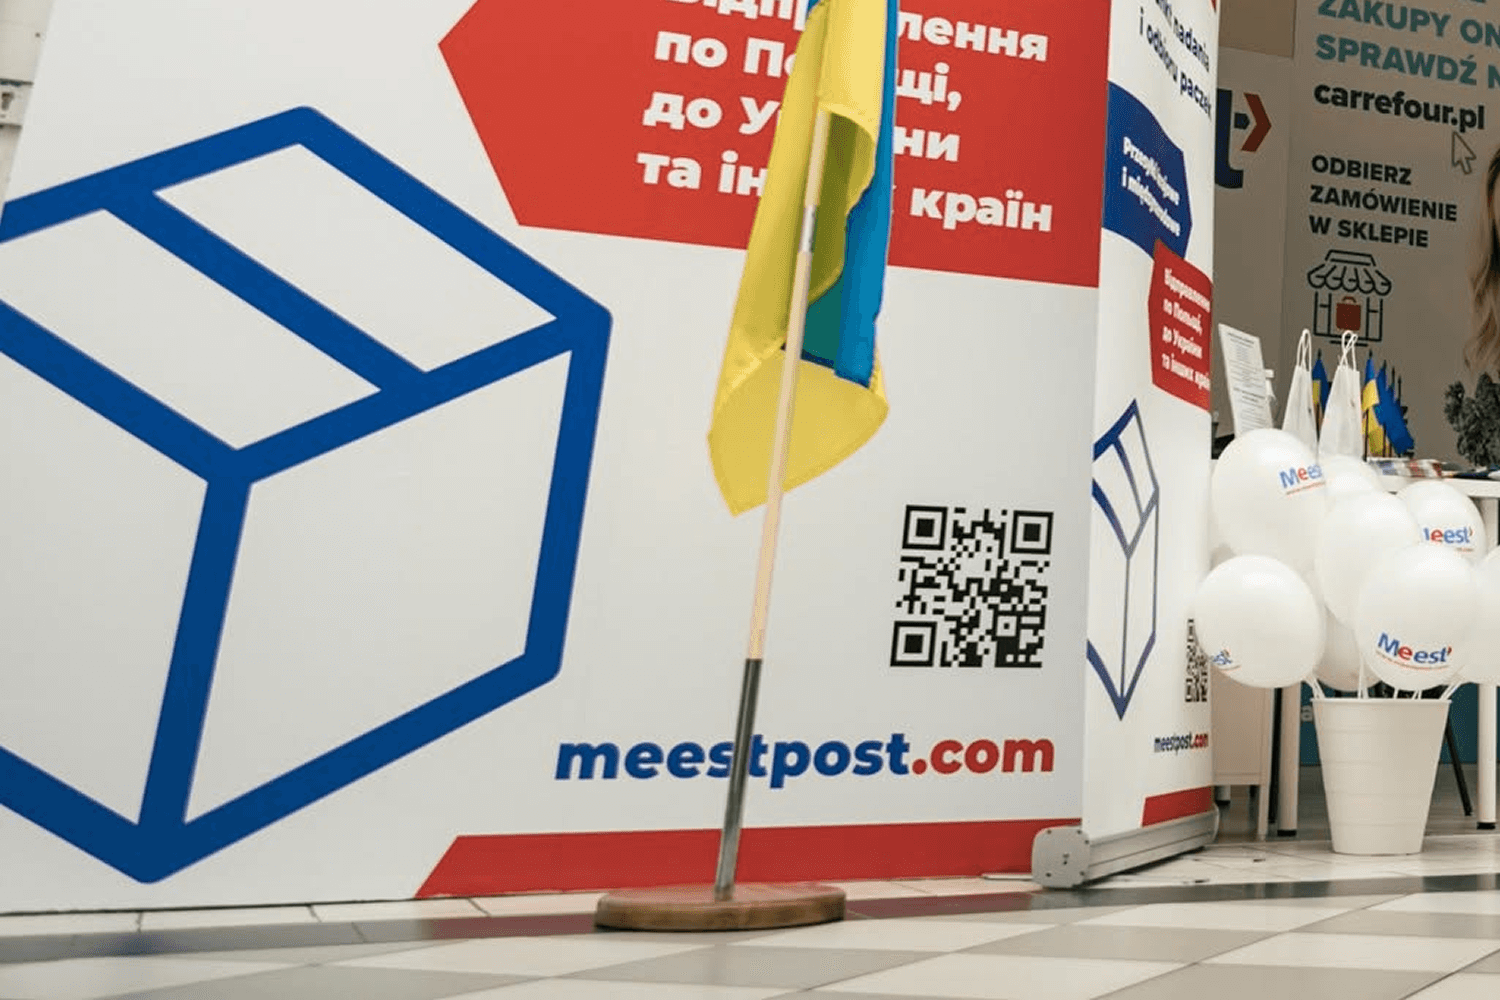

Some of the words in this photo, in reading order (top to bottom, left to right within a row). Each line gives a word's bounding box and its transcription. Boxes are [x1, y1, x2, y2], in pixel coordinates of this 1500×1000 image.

[655, 31, 727, 68] по
[743, 37, 962, 112] Пщі,
[1315, 34, 1478, 86] SPRAWDŹ
[643, 91, 722, 131] до
[1313, 84, 1486, 134] carrefour.pl
[636, 151, 701, 190] та
[1311, 155, 1413, 186] ODBIERZ
[910, 188, 1054, 232] країн
[1309, 184, 1459, 222] ZAMÓWIENIE
[1308, 215, 1332, 235] W
[1337, 218, 1430, 248] SKLEPIE
[1377, 632, 1449, 664] Meest
[554, 733, 1055, 788] meestpost.com
